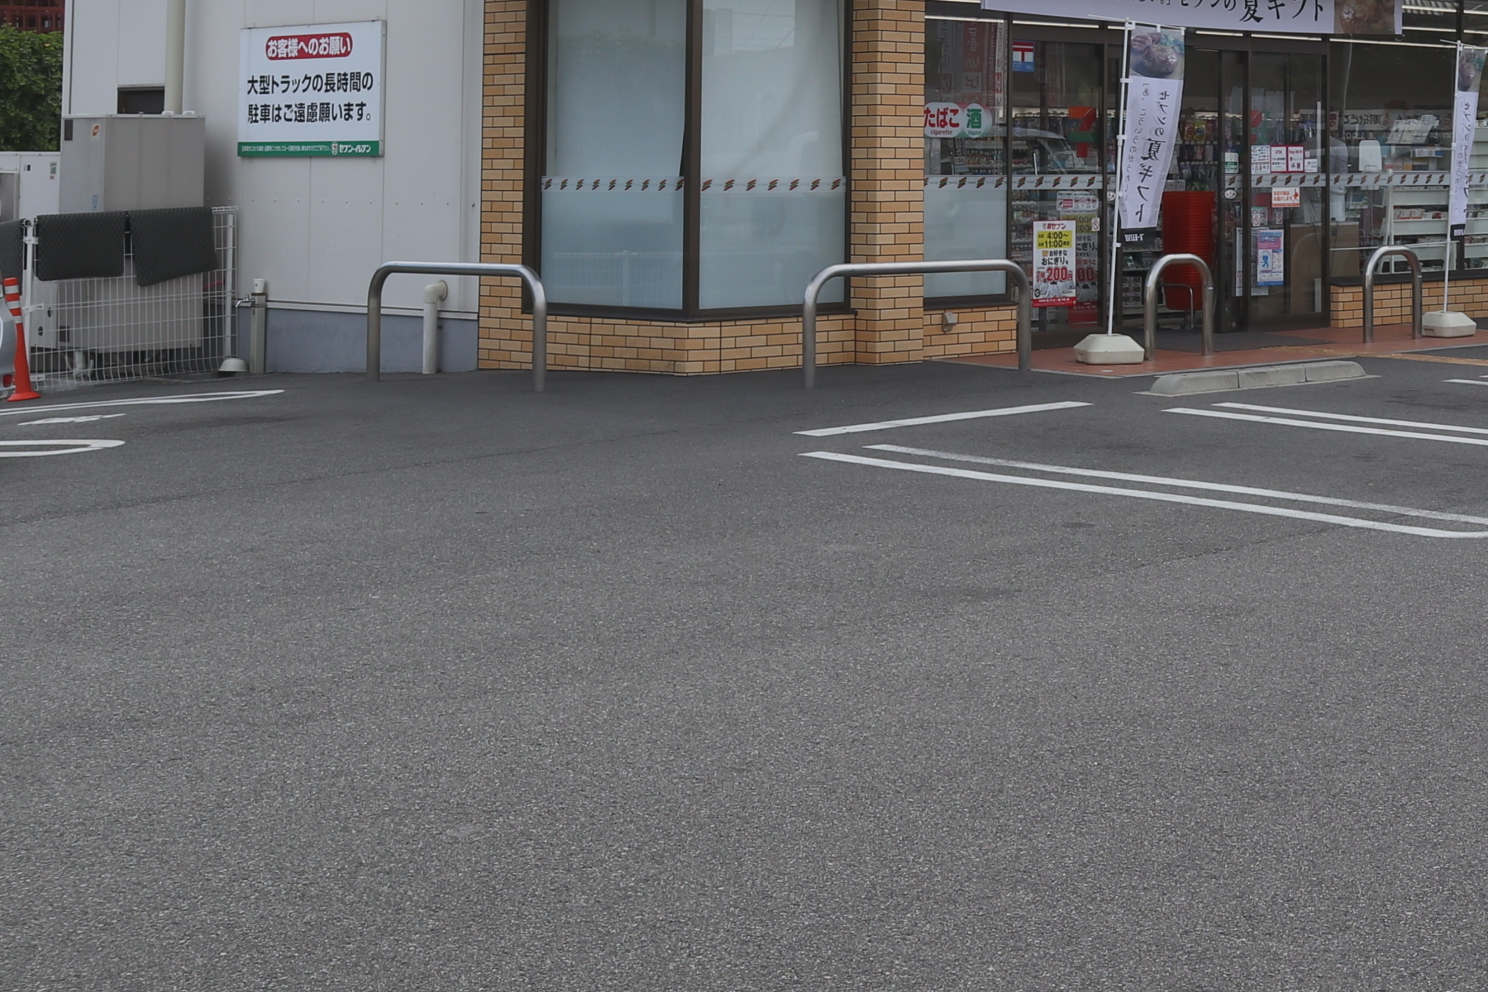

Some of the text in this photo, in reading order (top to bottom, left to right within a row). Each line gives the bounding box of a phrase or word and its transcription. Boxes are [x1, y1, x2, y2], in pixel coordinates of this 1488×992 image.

[267, 35, 352, 58] お客様へのお願い
[247, 71, 374, 95] 大型トラックの長時間の
[248, 101, 371, 123] 駐車はご遠慮願います。
[924, 107, 960, 128] たばこ
[966, 108, 982, 129] 酒
